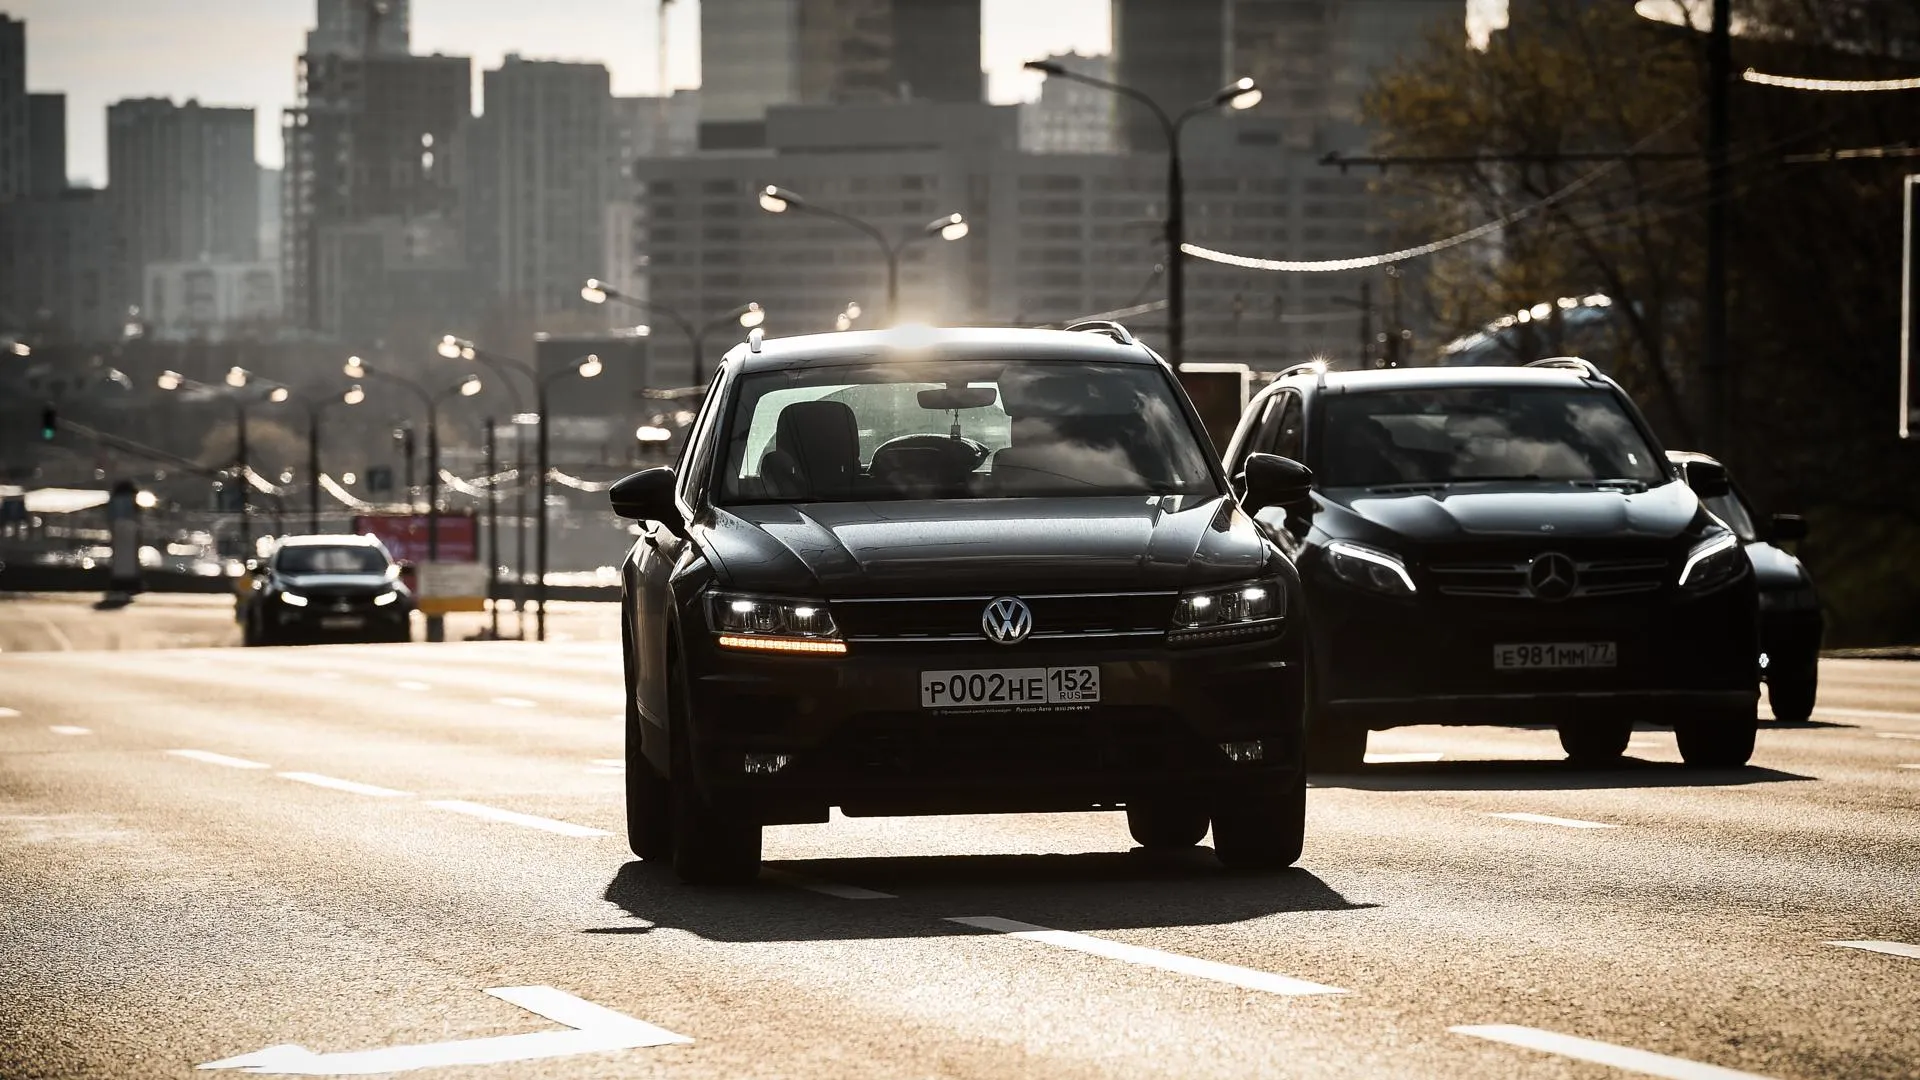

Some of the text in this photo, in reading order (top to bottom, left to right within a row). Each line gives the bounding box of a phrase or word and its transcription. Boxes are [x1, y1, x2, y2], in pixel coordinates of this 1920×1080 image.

[1591, 644, 1610, 660] 77
[1050, 669, 1093, 691] 152
[1059, 691, 1081, 700] RUS
